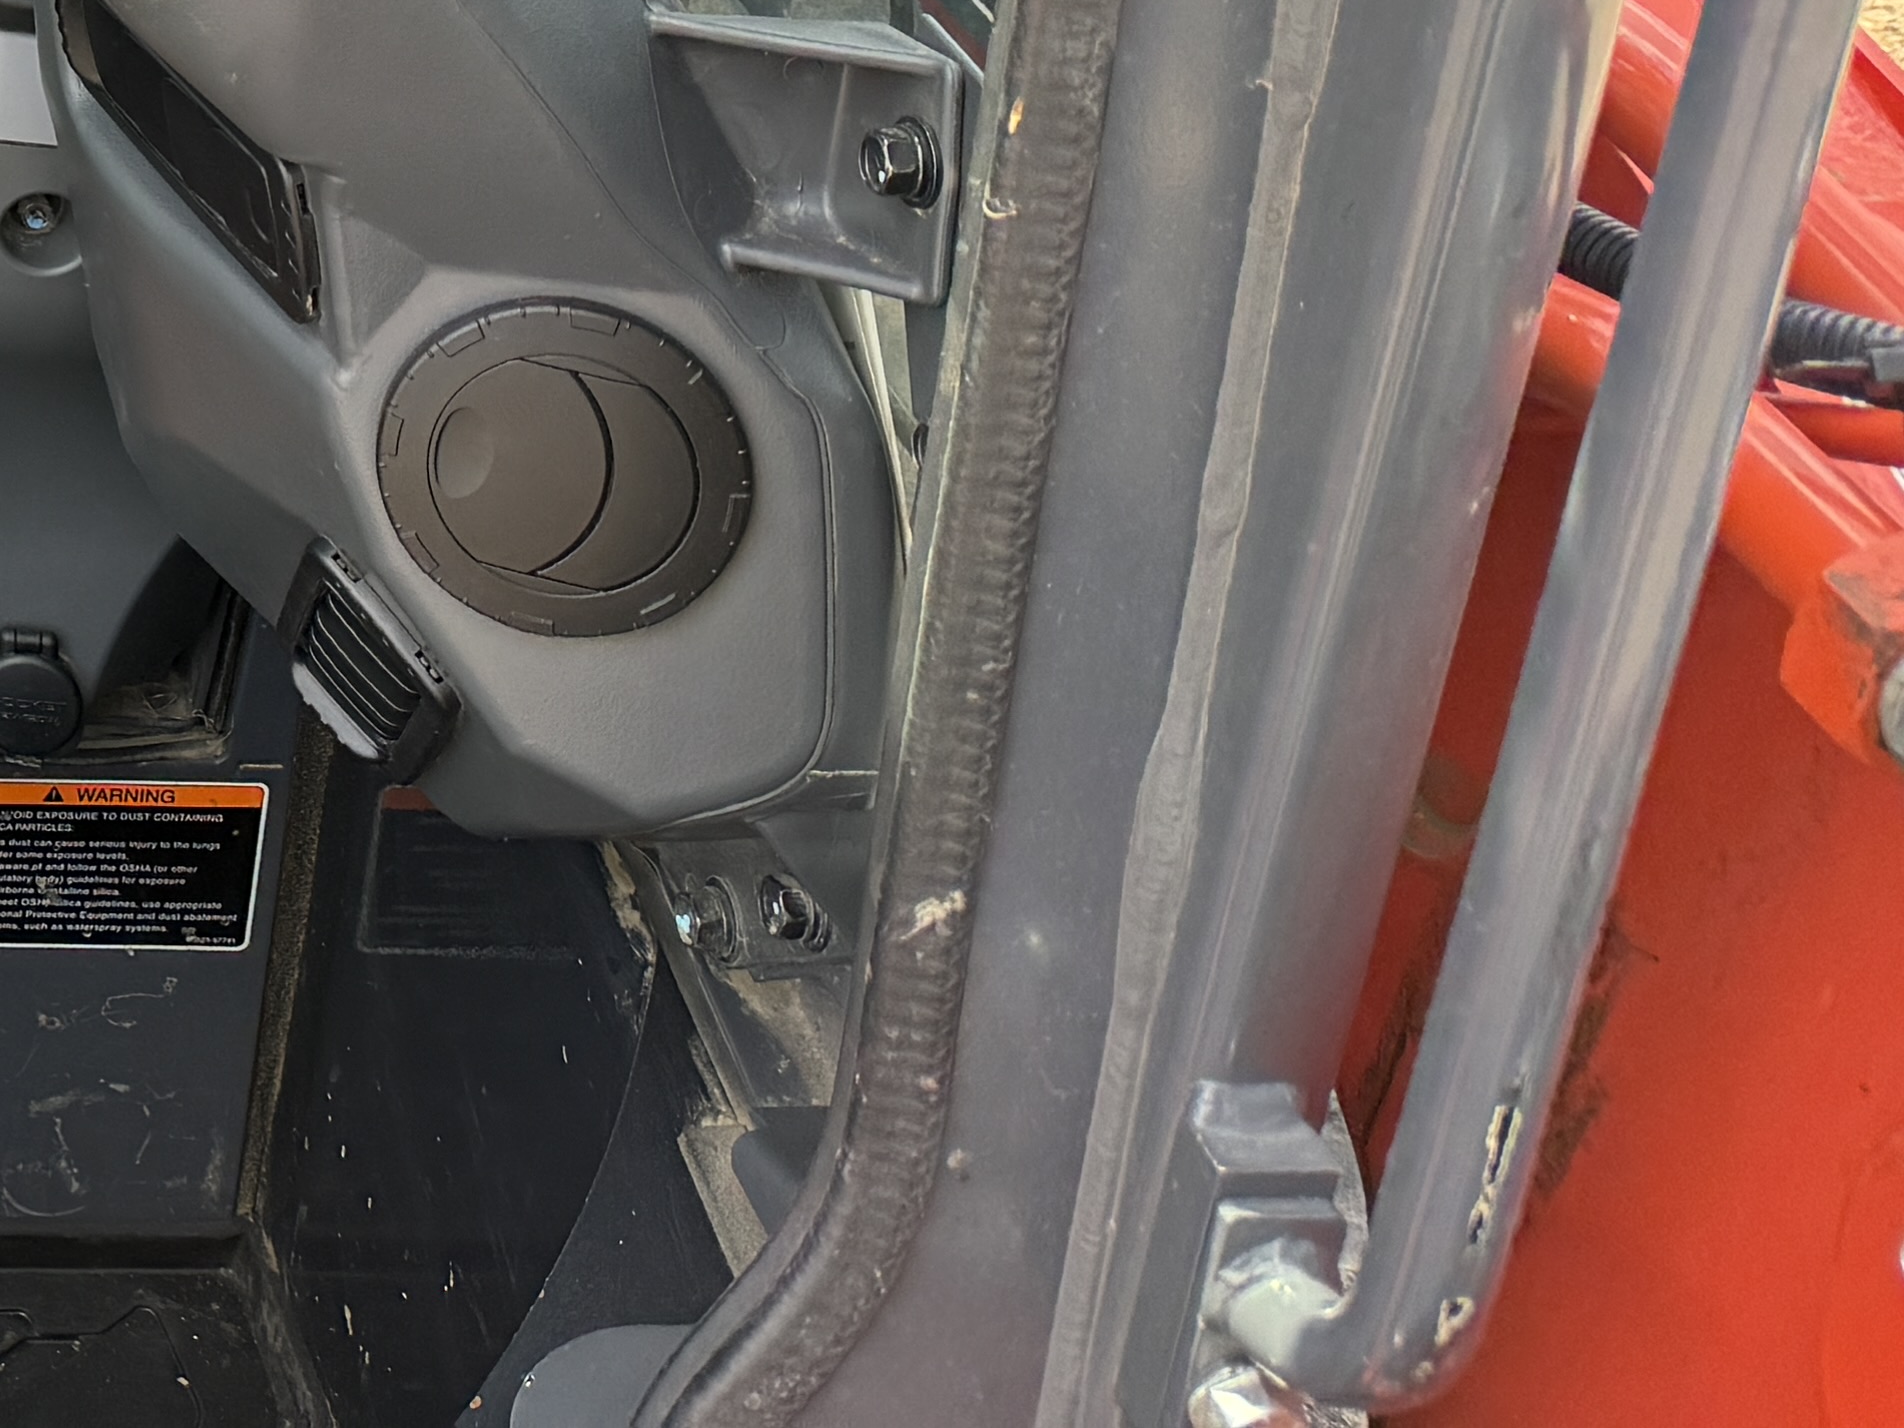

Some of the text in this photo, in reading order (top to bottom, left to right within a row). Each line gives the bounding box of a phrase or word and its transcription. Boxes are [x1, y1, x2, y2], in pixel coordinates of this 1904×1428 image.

[77, 787, 175, 803] WARNING
[36, 811, 98, 820] EXPOSURE
[120, 812, 150, 821] DUST
[154, 813, 224, 822] CONTAINING
[9, 839, 30, 847] dust
[129, 841, 157, 850] injury
[192, 842, 220, 850] lungs
[120, 864, 150, 872] OSHA
[66, 876, 118, 884] guidelines
[164, 901, 222, 909] appropriate
[79, 912, 134, 920] Equipment
